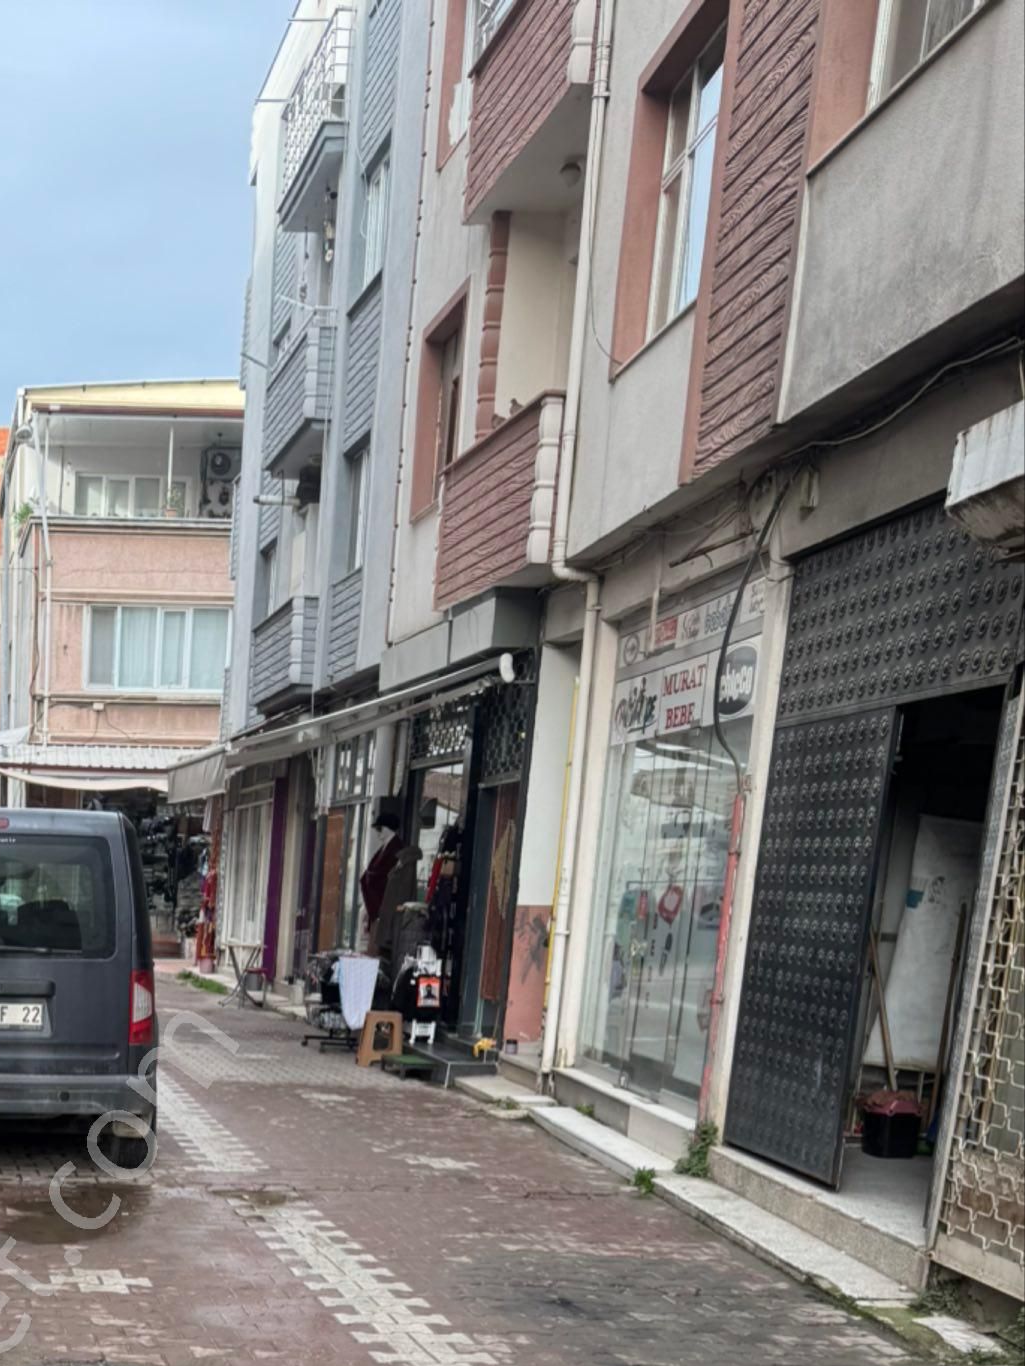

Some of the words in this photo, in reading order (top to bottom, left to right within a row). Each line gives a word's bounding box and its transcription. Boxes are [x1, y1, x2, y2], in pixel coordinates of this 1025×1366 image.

[662, 664, 707, 697] MURAT
[664, 702, 696, 730] BEBE
[22, 1007, 40, 1023] 22
